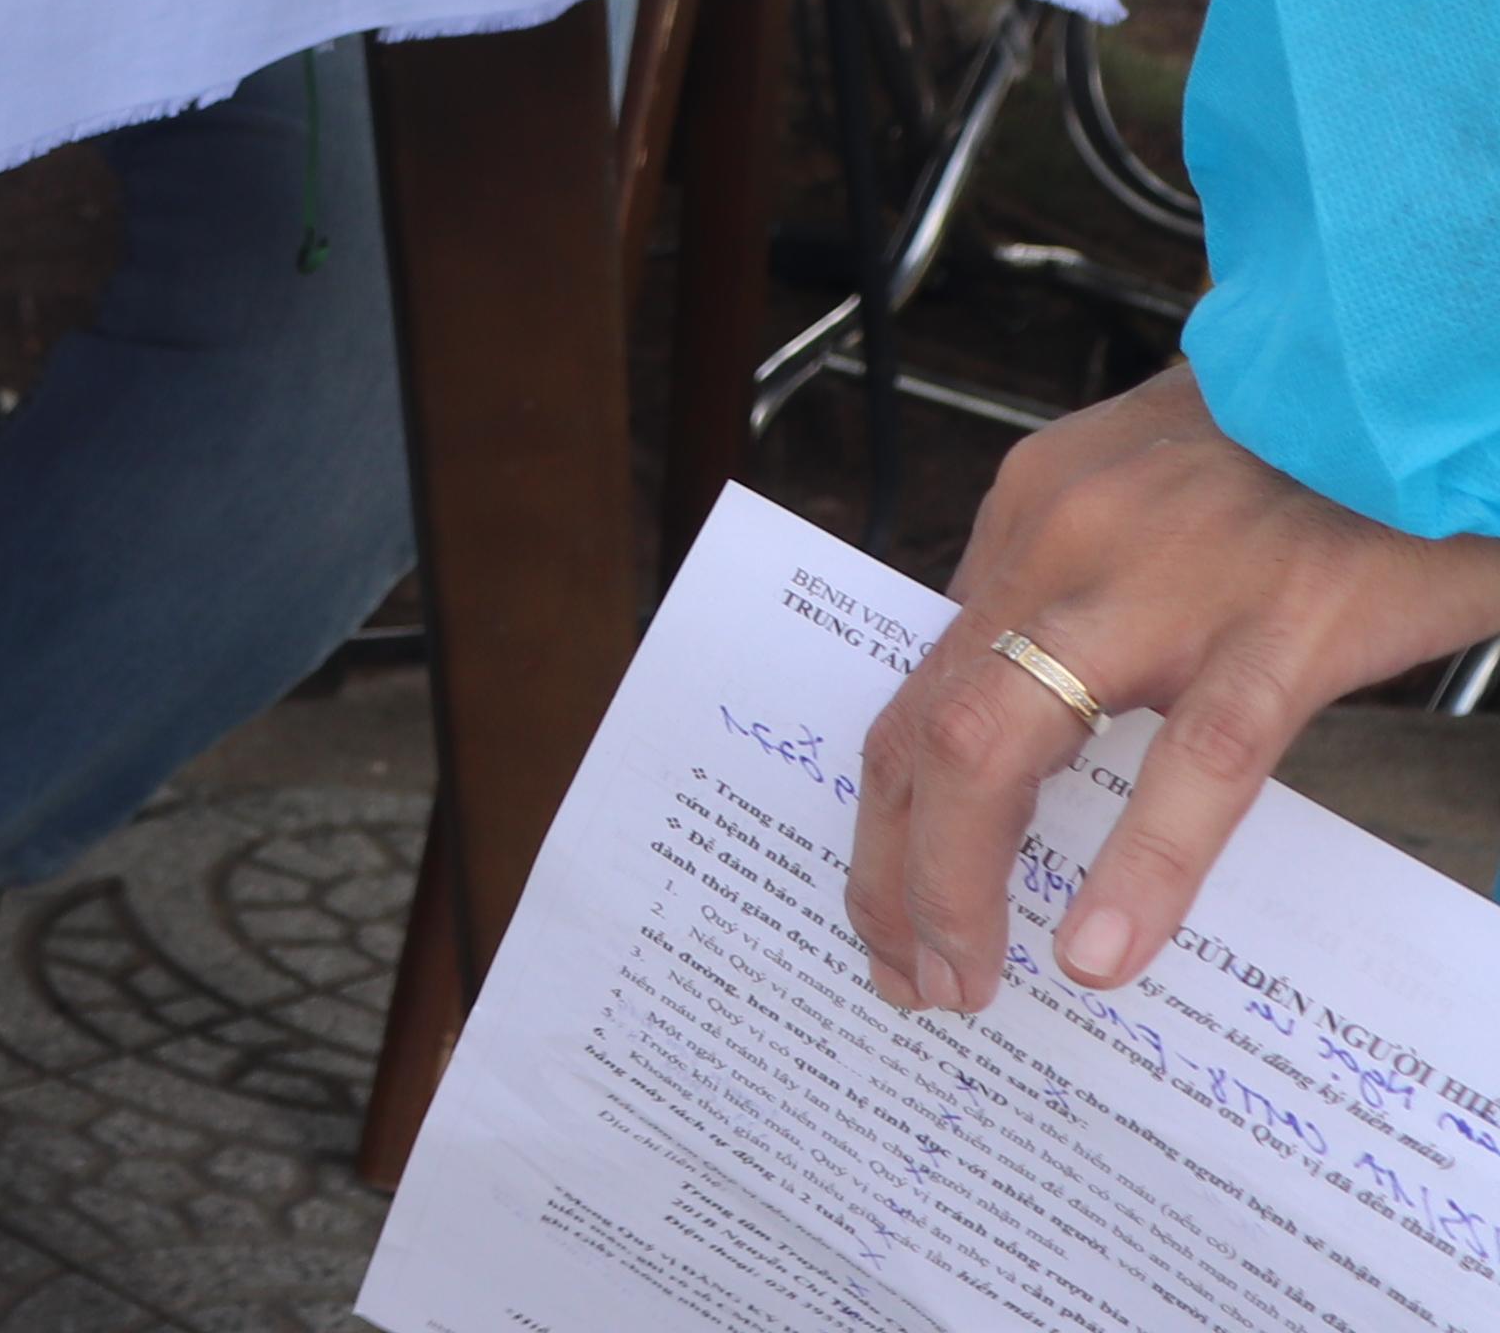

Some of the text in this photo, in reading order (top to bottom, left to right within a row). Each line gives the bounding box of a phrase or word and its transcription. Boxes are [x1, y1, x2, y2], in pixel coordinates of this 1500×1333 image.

[780, 588, 864, 647] TRUNG
[789, 565, 858, 616] BỆNH
[858, 603, 918, 651] VIỆN
[674, 790, 712, 819] cứu
[713, 813, 762, 852] bệnh
[712, 778, 815, 852] Trung tâm
[799, 905, 826, 926] an
[648, 839, 698, 876] dành
[699, 872, 740, 904] thời
[739, 900, 783, 932] gian
[784, 928, 821, 957] đọc
[914, 1015, 973, 1059] thông
[974, 1053, 1003, 1077] tin
[1005, 1074, 1040, 1100] sau
[1237, 959, 1316, 1018] ĐẾN
[1313, 1001, 1438, 1088] NGƯỜI
[634, 1029, 690, 1071] Trước
[690, 1067, 721, 1092] khi
[807, 1146, 849, 1178] Quý
[850, 1174, 871, 1194] vị
[645, 1010, 684, 1041] Một
[683, 1038, 728, 1071] ngày
[729, 1067, 778, 1103] trước
[866, 1158, 909, 1190] Quý
[910, 1183, 931, 1204] vị
[933, 1198, 989, 1238] tránh
[991, 1233, 1043, 1272] uống
[1043, 1267, 1095, 1304] rượu
[1098, 1299, 1131, 1326] bia
[658, 992, 699, 1023] máu
[723, 1036, 770, 1072] tránh
[770, 1066, 801, 1092] lây
[802, 1087, 832, 1113] lan
[833, 1108, 879, 1143] bệnh
[974, 1196, 1022, 1230] nhận
[665, 968, 705, 1000] Nếu
[704, 995, 746, 1027] Quý
[746, 1023, 766, 1043] vị
[767, 1038, 792, 1057] có
[792, 1056, 841, 1091] quan
[844, 1087, 869, 1110] hệ
[956, 1155, 988, 1180] với
[1116, 1257, 1149, 1283] với
[686, 924, 727, 957] Nếu
[726, 952, 768, 985] Quý
[769, 980, 789, 1000] vị
[788, 994, 836, 1031] đang
[878, 1052, 911, 1077] các
[913, 1072, 960, 1108] bệnh
[998, 1124, 1037, 1154] tính
[1038, 1148, 1085, 1185] hoặc
[1086, 1181, 1112, 1202] có
[1112, 1200, 1147, 1227] các
[1147, 1222, 1196, 1261] bệnh
[698, 903, 739, 936] Quý
[740, 931, 761, 951] vị
[794, 969, 847, 1009] mang
[848, 1002, 890, 1034] theo
[889, 1030, 935, 1063] giấy
[1012, 1105, 1036, 1125] và
[1113, 1171, 1158, 1205] máu
[1282, 1283, 1319, 1314] lần
[744, 993, 781, 1023] hen
[867, 1074, 899, 1098] xin
[995, 1151, 1038, 1182] máu
[1147, 1252, 1172, 1272] an
[1217, 1301, 1255, 1329] cho
[977, 1024, 1029, 1064] cũng
[1029, 1057, 1074, 1090] như
[1073, 1086, 1111, 1115] cho
[1112, 1111, 1182, 1162] những
[1181, 1156, 1245, 1202] người
[1245, 1195, 1300, 1237] bệnh
[1326, 1248, 1383, 1290] nhận
[1027, 984, 1061, 1011] xin
[1063, 1007, 1108, 1042] trân
[1109, 1038, 1168, 1082] trọng
[1248, 1122, 1298, 1160] Quý
[1299, 1153, 1323, 1177] vị
[1323, 1169, 1354, 1194] đã
[1457, 1250, 1496, 1282] gia
[1163, 992, 1223, 1033] trước
[1223, 1026, 1263, 1056] khi
[1259, 1050, 1316, 1091] đăng
[1315, 1081, 1347, 1107] ký
[1395, 1129, 1456, 1172] máu)
[731, 1123, 772, 1153] gian
[1001, 1297, 1047, 1329] máu
[778, 1176, 797, 1194] là
[798, 1190, 812, 1205] 2
